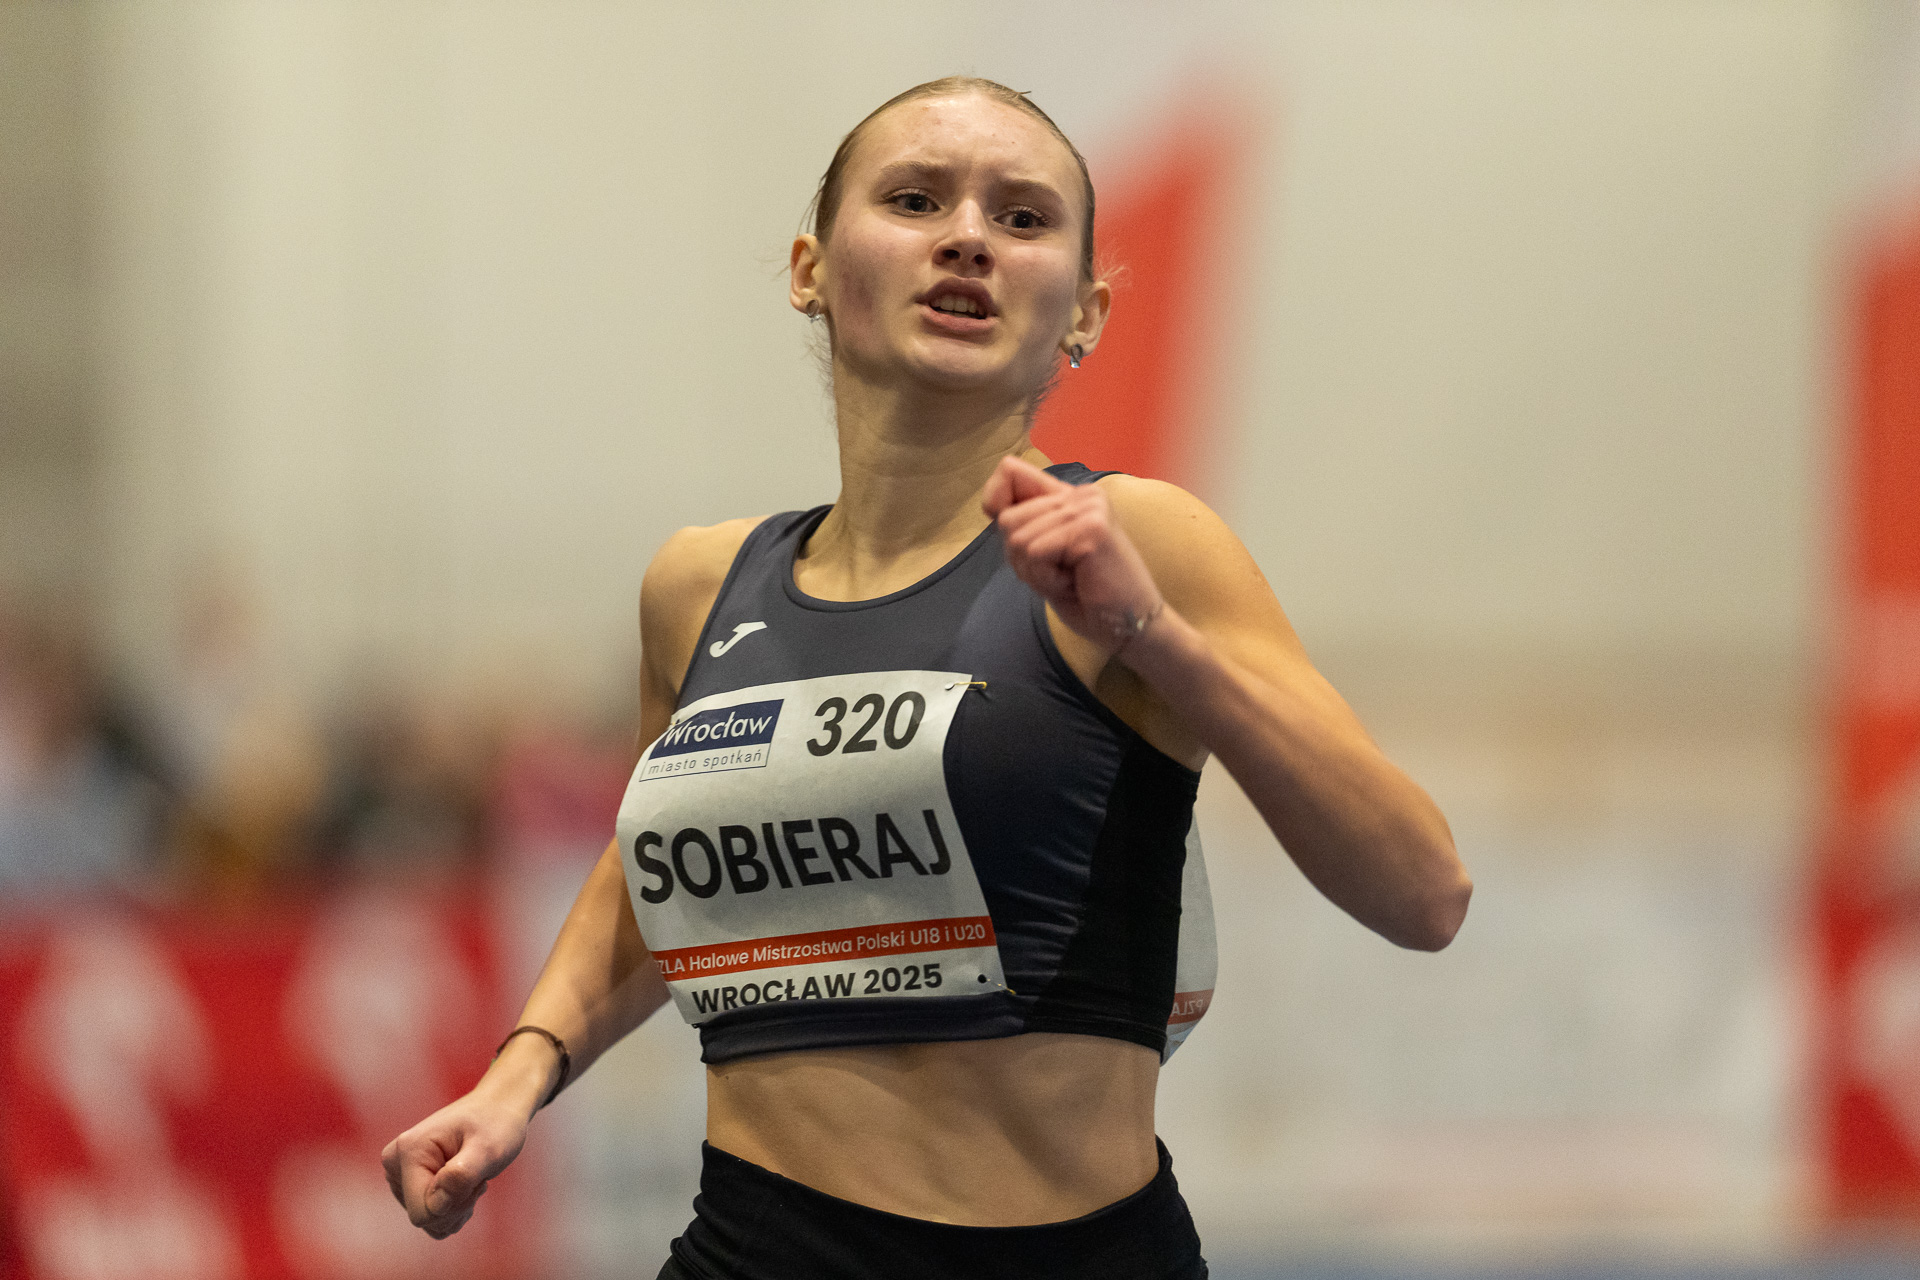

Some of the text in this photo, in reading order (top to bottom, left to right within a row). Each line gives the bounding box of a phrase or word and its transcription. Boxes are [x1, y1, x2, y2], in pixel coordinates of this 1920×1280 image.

[663, 711, 773, 748] Wrocław
[806, 691, 926, 757] 320
[648, 749, 762, 775] miasto spotkań
[634, 808, 952, 904] SOBIERAJ
[689, 951, 749, 971] Halowe
[753, 939, 852, 963] Mistrzostwa
[856, 930, 905, 950] Polski
[910, 927, 940, 945] U18
[944, 926, 950, 942] i
[954, 924, 986, 941] U20
[692, 963, 943, 1014] WROCŁAW 2025
